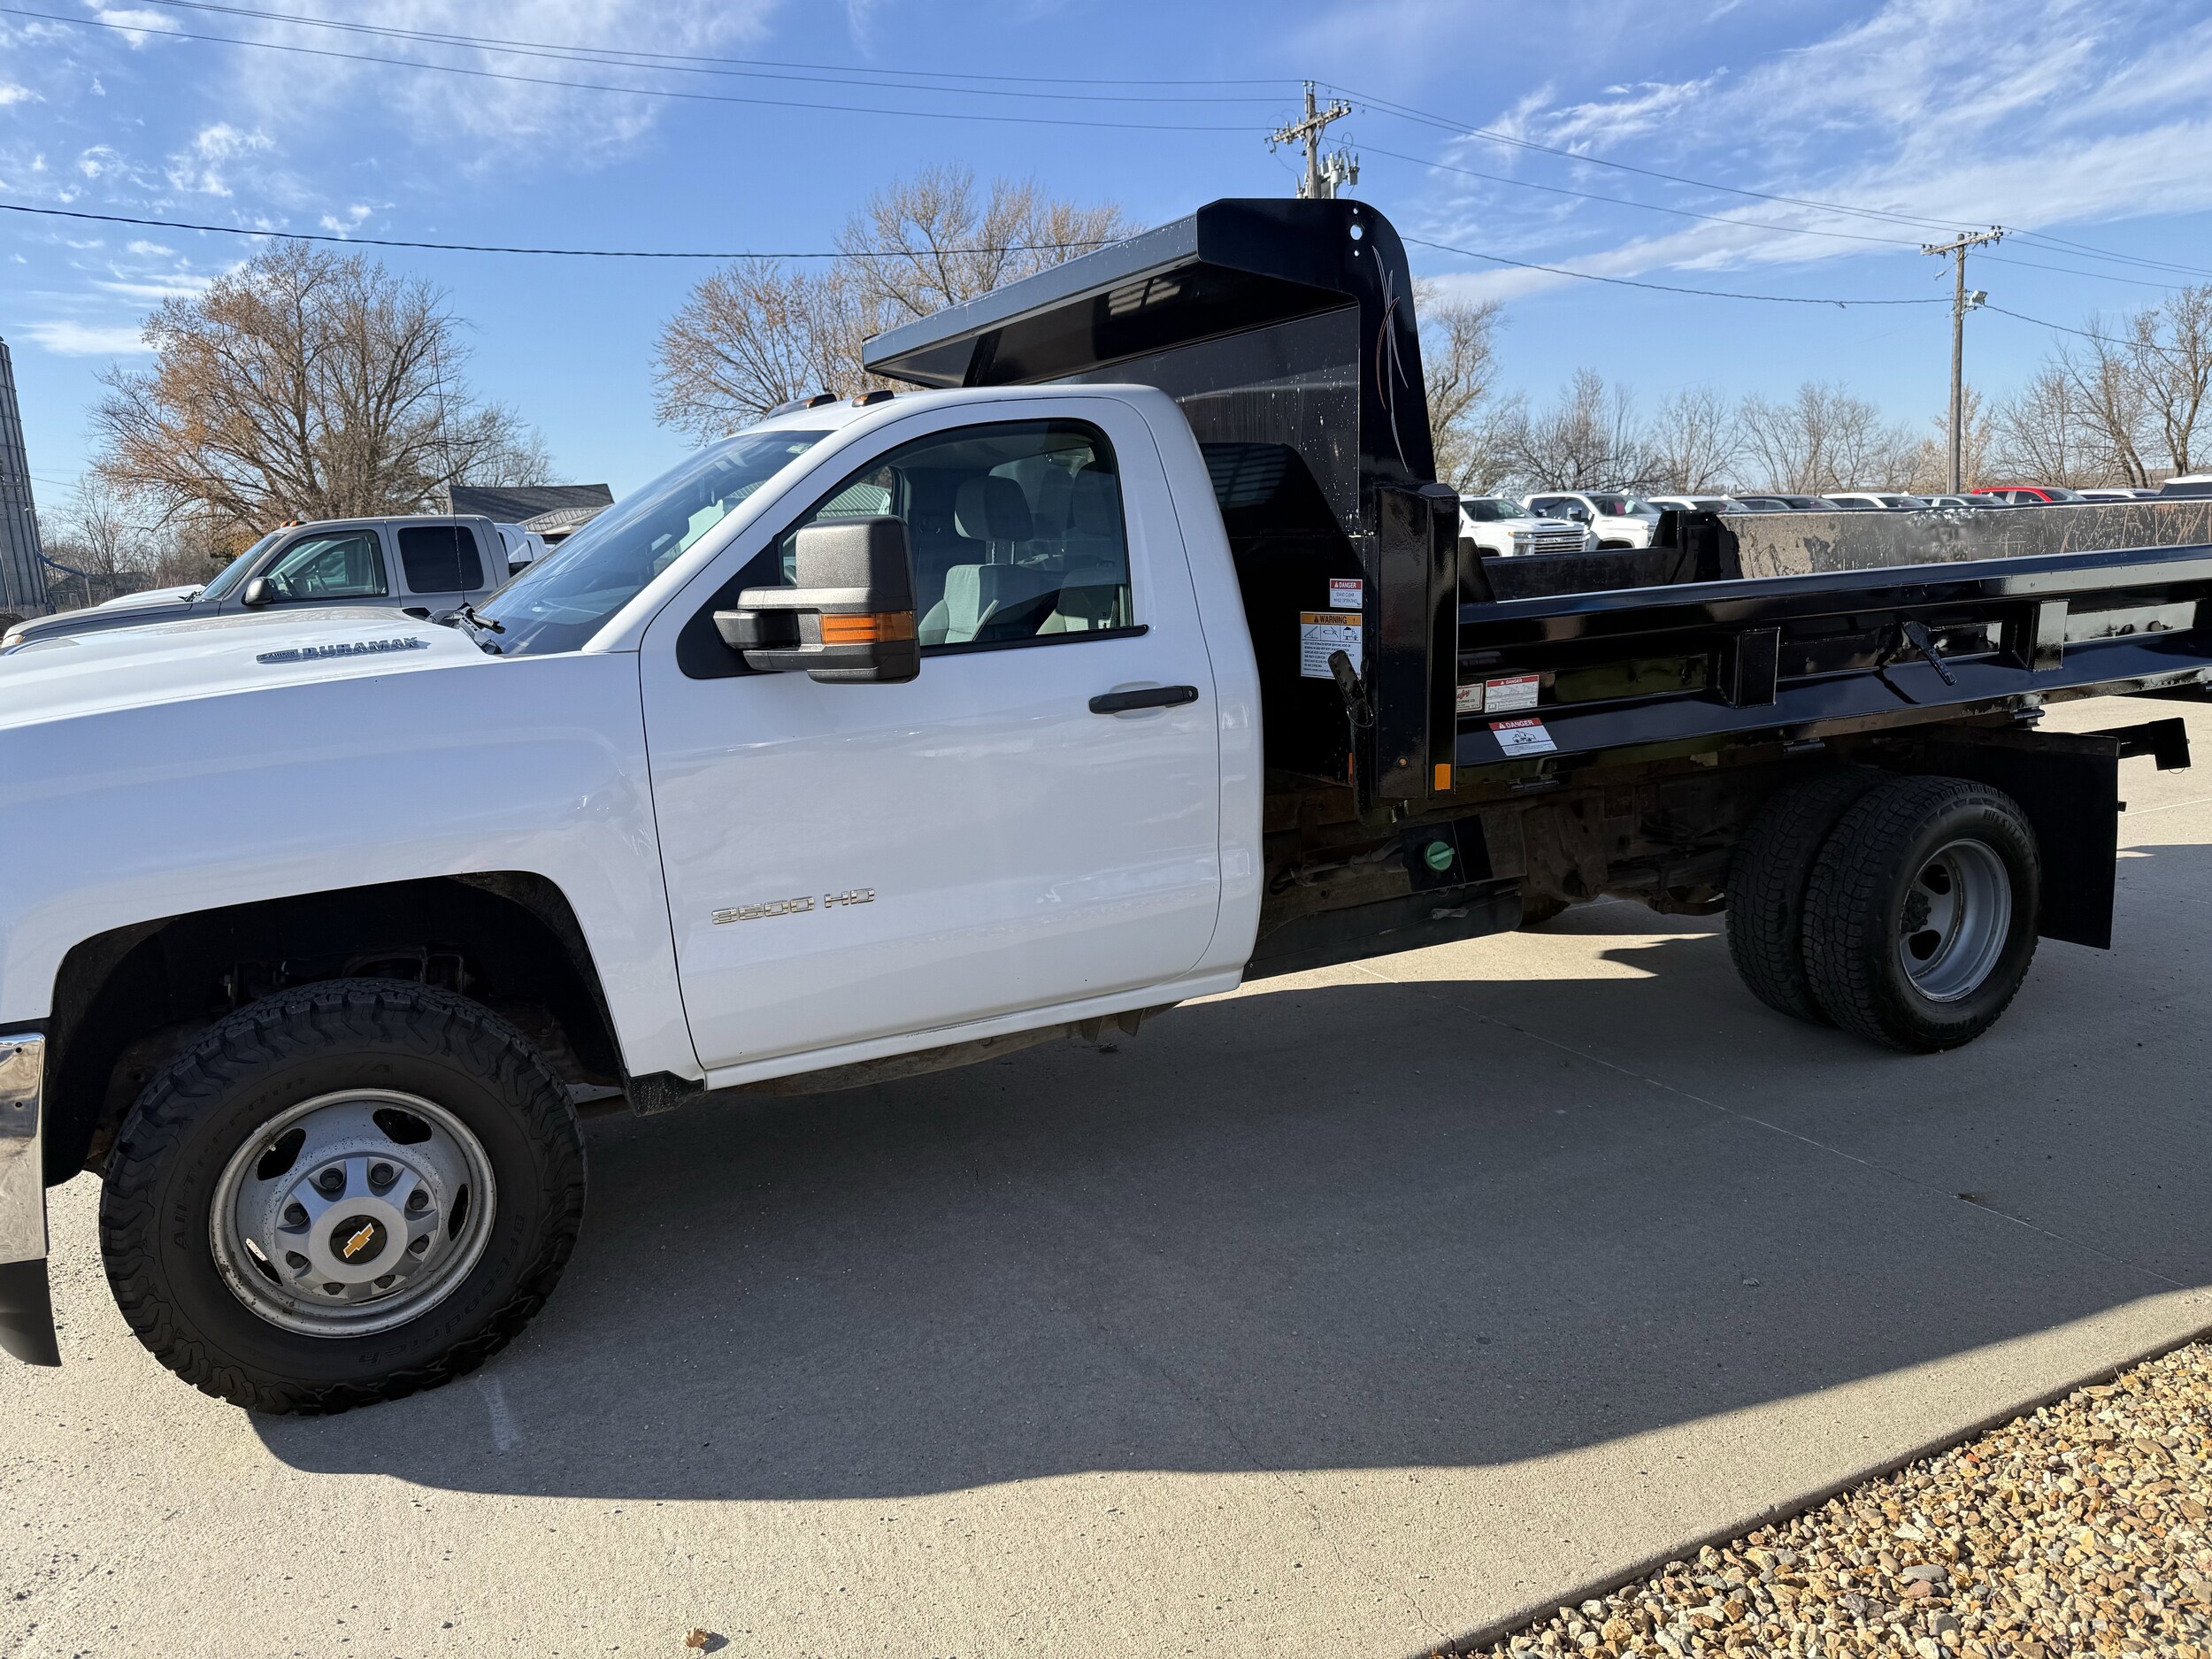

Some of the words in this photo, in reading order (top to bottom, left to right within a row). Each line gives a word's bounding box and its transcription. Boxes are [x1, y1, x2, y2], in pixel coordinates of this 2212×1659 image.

[1319, 615, 1348, 624] WARNING
[302, 637, 419, 659] DURAMAX
[1505, 719, 1534, 728] DANGER
[711, 896, 815, 925] 3500
[824, 887, 875, 909] HD
[354, 1213, 526, 1367] BFGoodrich
